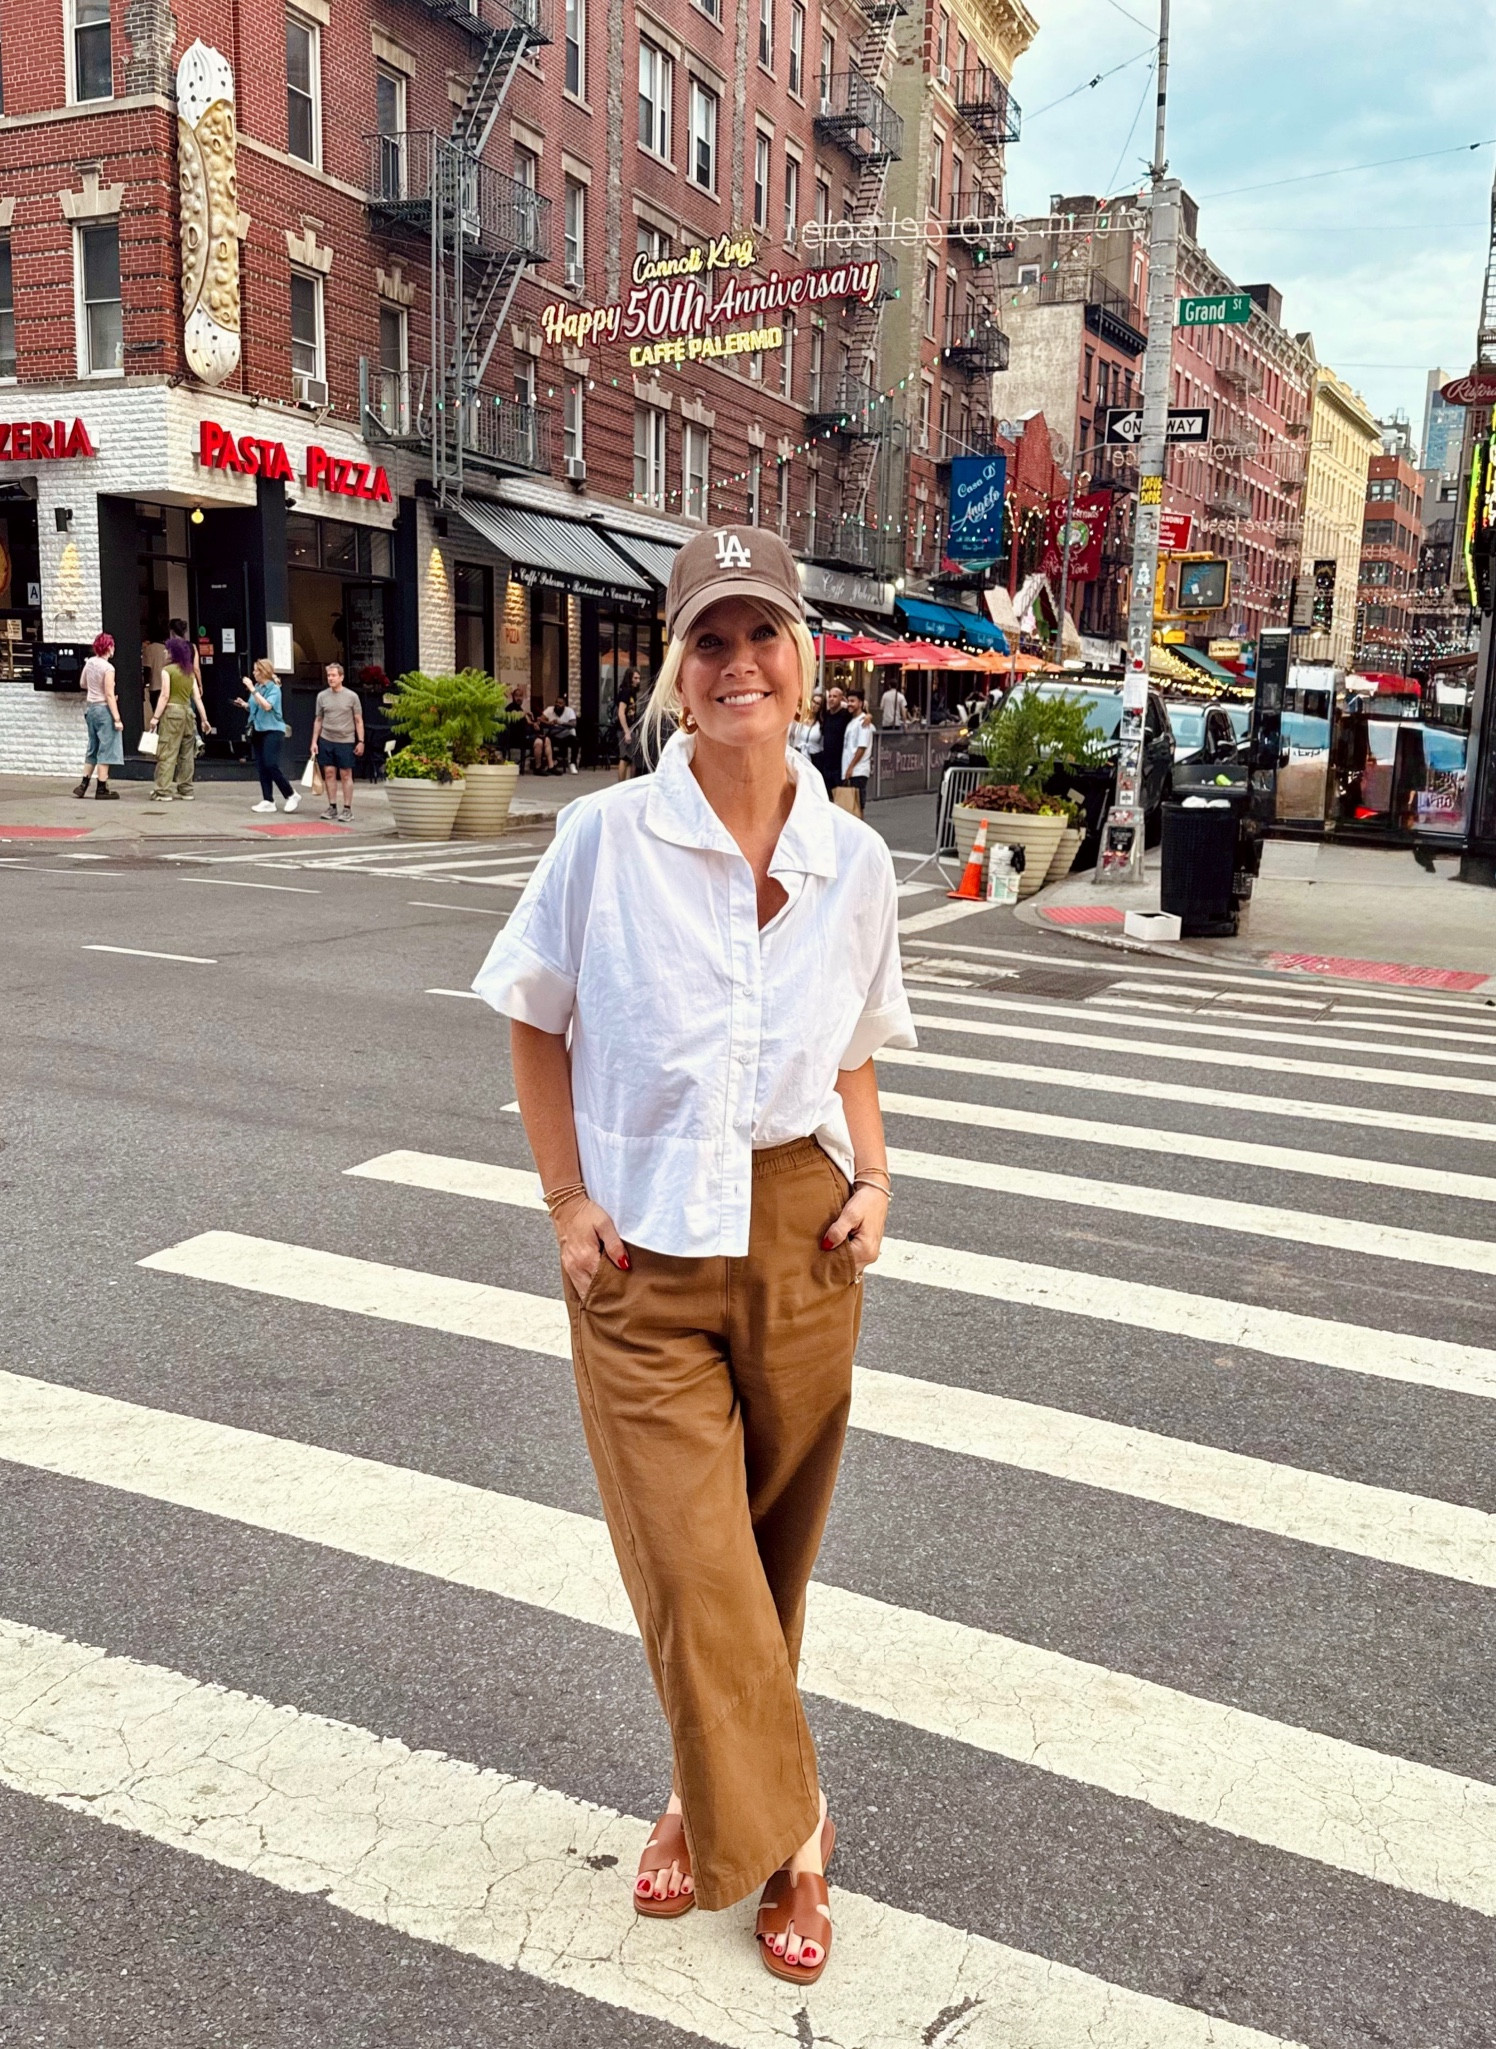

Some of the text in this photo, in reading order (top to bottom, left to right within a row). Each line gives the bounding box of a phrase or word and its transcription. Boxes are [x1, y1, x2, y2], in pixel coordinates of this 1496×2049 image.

[632, 232, 756, 285] Cannoli King
[541, 261, 881, 347] Happy 50th Anniversary
[1185, 298, 1242, 322] Grand St
[689, 326, 783, 360] PALERMO
[1167, 419, 1196, 433] WAY
[200, 420, 393, 503] PASTA PIZZA
[957, 478, 984, 499] Casa
[951, 486, 1001, 532] Angelo
[1054, 505, 1100, 519] Chistmas
[713, 530, 752, 569] LA
[1070, 563, 1089, 575] York
[30, 585, 39, 599] A
[896, 751, 925, 773] PIZZERIA
